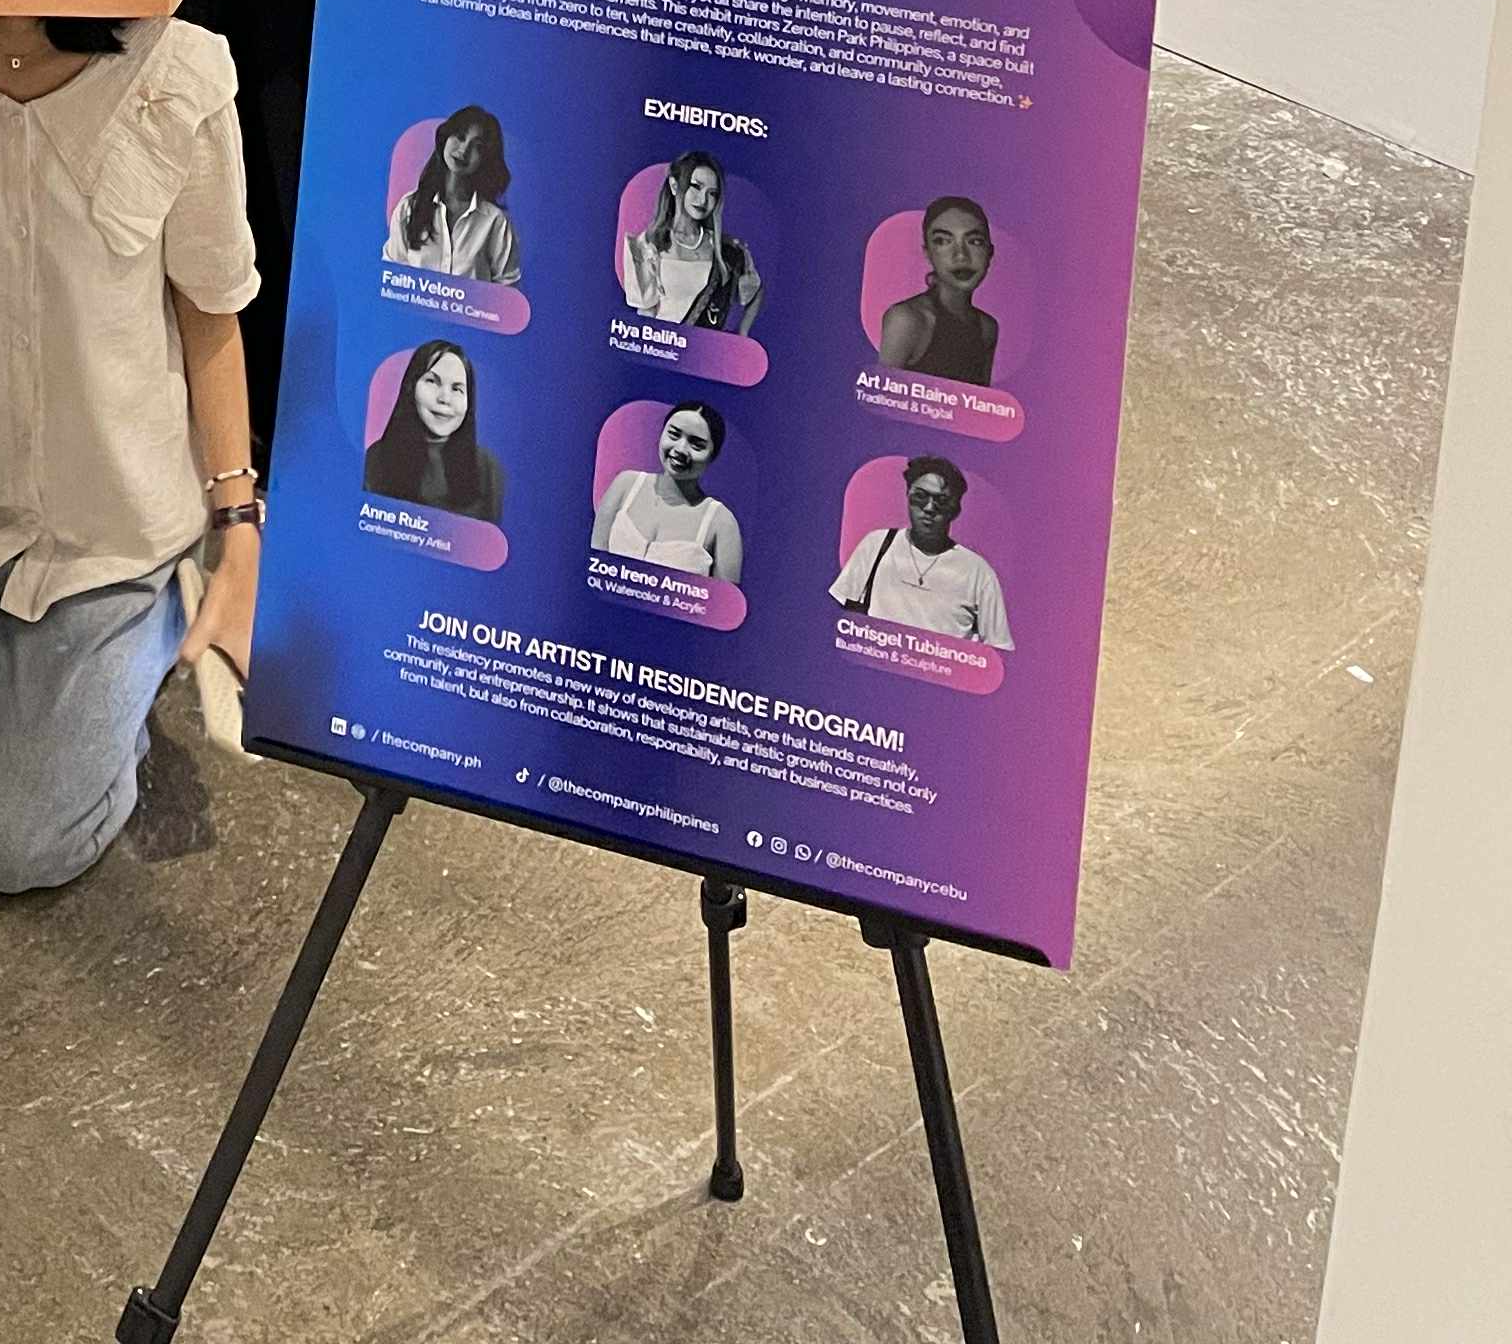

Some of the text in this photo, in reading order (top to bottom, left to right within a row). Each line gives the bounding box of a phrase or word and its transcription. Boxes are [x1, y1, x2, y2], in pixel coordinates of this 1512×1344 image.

[497, 2, 532, 20] ideas
[534, 8, 557, 24] into
[559, 16, 637, 39] experiences
[640, 27, 664, 44] that
[714, 44, 750, 59] spark
[809, 61, 835, 74] and
[837, 63, 874, 81] leave
[876, 72, 885, 83] a
[887, 71, 932, 94] lasting
[689, 4, 731, 22] exhibit
[733, 12, 779, 31] mirrors
[782, 19, 834, 40] Zeroten
[837, 28, 867, 46] Park
[946, 51, 956, 61] a
[958, 52, 1002, 69] space
[1004, 57, 1033, 75] built
[1002, 26, 1030, 39] and
[644, 98, 767, 137] EXHIBITORS:
[382, 270, 464, 299] Faith Veloro
[610, 319, 686, 347] Hya Baliña
[856, 371, 1015, 417] Art Jan Elaine Ylanan
[359, 503, 428, 531] Anne Ruiz
[588, 557, 708, 599] Zoe Irene Armas
[837, 618, 986, 667] Chrisgel Tubianosa
[406, 634, 429, 651] This
[431, 643, 491, 669] residency
[492, 659, 552, 683] promotes
[554, 675, 563, 686] a
[564, 678, 592, 693] new
[594, 686, 620, 703] way
[621, 692, 635, 704] of
[637, 696, 707, 727] developing
[753, 728, 779, 742] one
[781, 732, 807, 750] that
[809, 739, 854, 762] blends
[418, 610, 903, 751] JOIN OUR ARTIST IN RESIDENCE PROGRAM!
[382, 731, 481, 767] thecompany.ph
[454, 666, 477, 680] and
[587, 698, 595, 712] It
[597, 703, 638, 723] shows
[641, 713, 665, 730] that
[667, 723, 739, 749] sustainable
[741, 742, 784, 761] artistic
[786, 754, 832, 774] growth
[834, 766, 880, 787] comes
[883, 779, 905, 793] not
[907, 785, 937, 804] only
[548, 776, 718, 833] @thecompanyphilippines
[826, 852, 966, 900] @thecompanycebu
